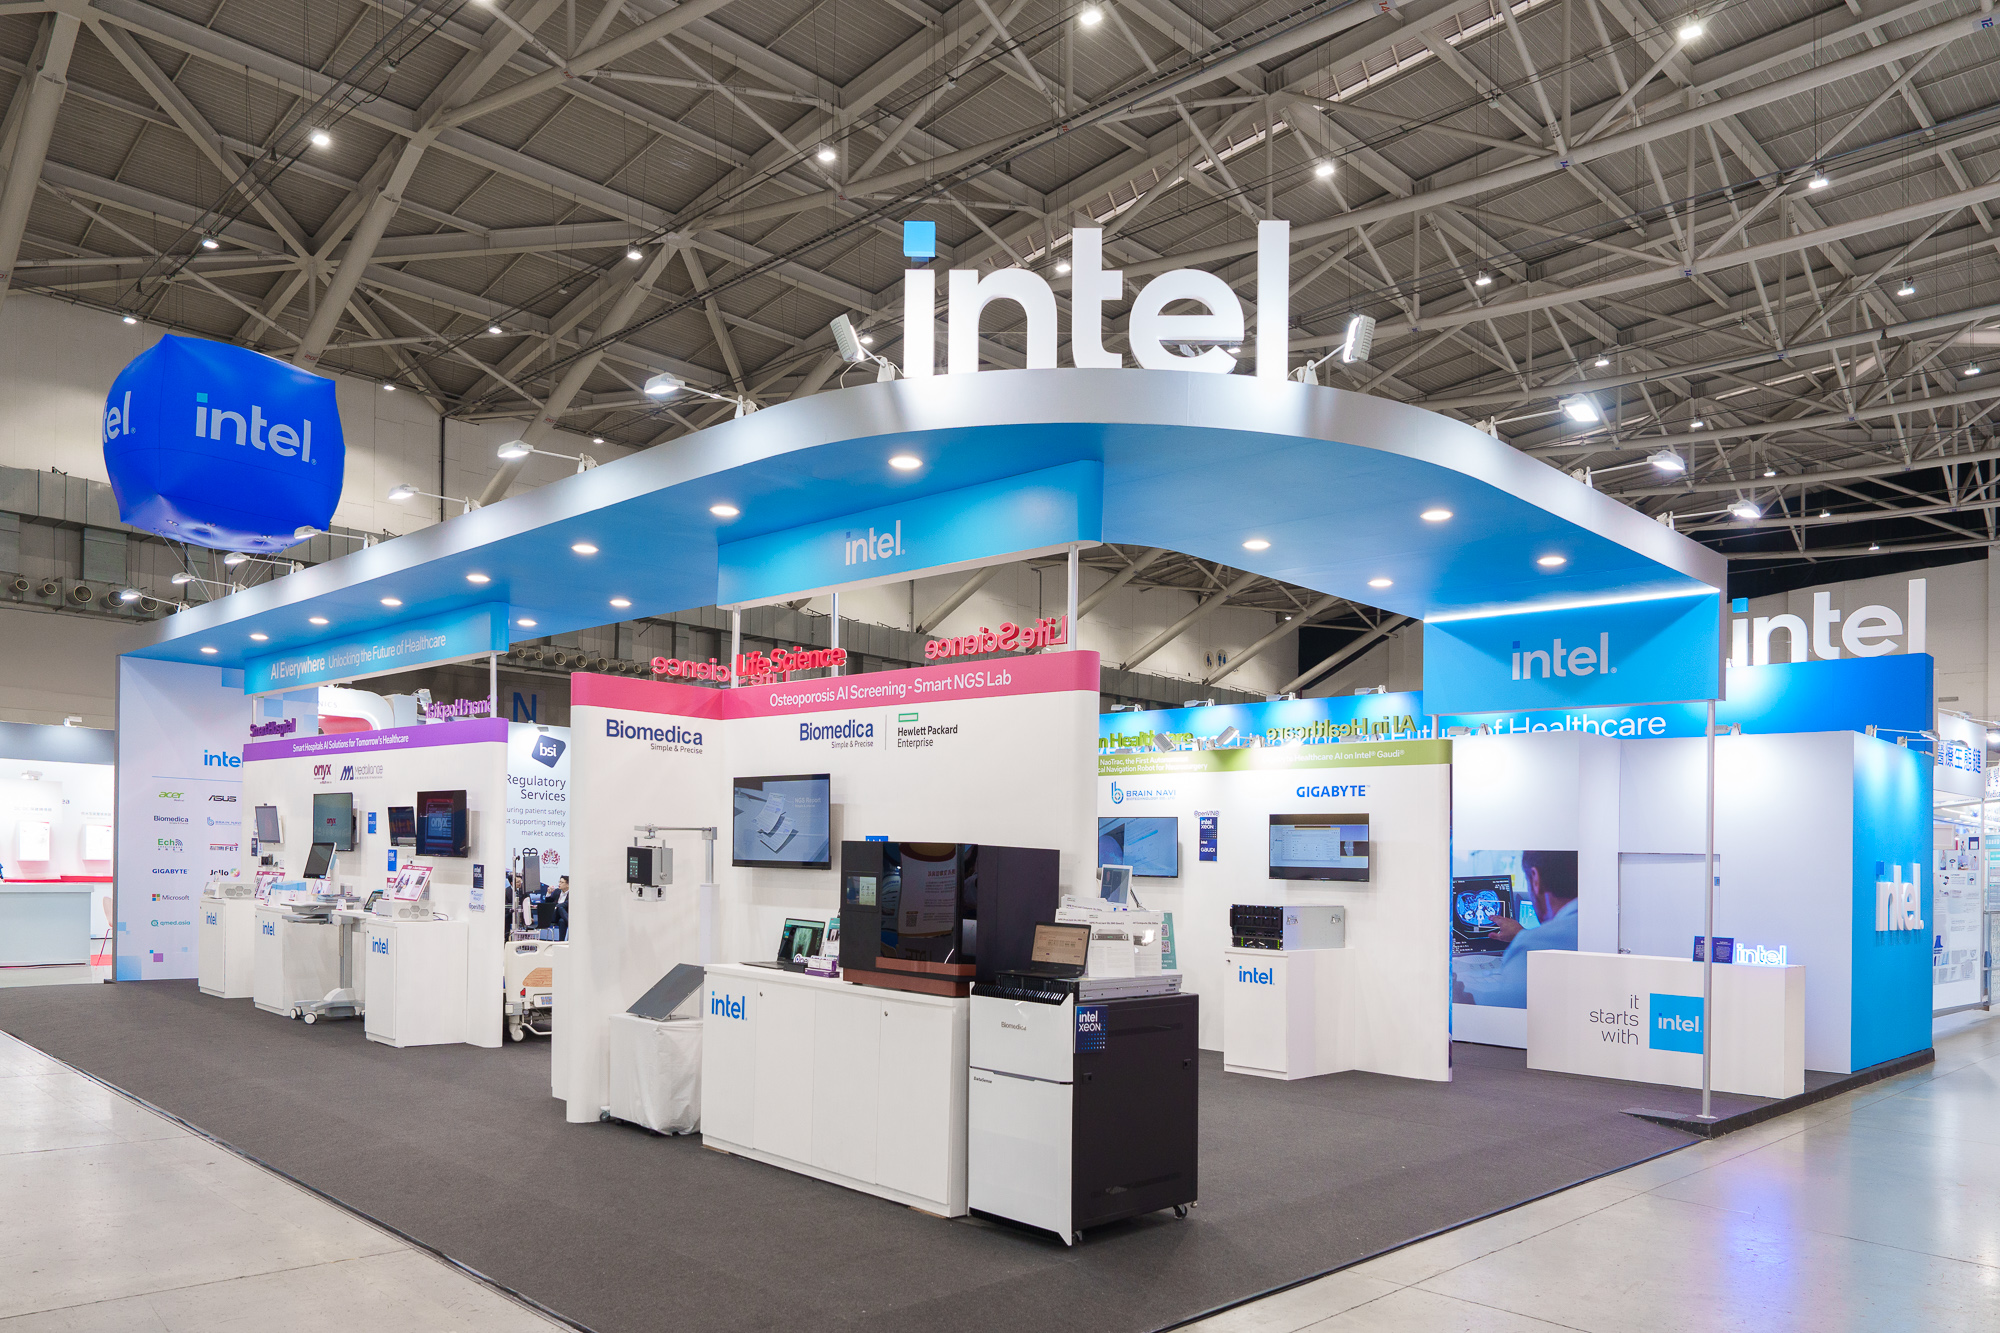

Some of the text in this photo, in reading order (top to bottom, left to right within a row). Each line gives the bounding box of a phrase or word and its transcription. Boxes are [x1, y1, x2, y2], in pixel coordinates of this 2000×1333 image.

[903, 220, 1290, 381] intel
[1731, 578, 1926, 667] intel
[270, 634, 446, 680] AI Everywhere Unlocking the Future of Healthcare
[736, 646, 847, 677] Life Science
[769, 687, 835, 708] Osteoporosis
[836, 686, 849, 701] AI
[849, 681, 907, 701] Screening
[914, 677, 952, 694] Smart
[953, 672, 985, 689] NGS
[986, 670, 1012, 687] Lab
[513, 692, 537, 722] N
[606, 718, 703, 746] Biomedica
[799, 719, 874, 743] Biomedica
[897, 723, 958, 737] Hewlett Packard
[1509, 713, 1667, 738] Healthcare
[293, 742, 305, 753] Smart
[305, 741, 324, 753] Hospitals
[324, 741, 329, 750] AI
[329, 740, 348, 750] Solutions
[382, 735, 409, 746] Healthcare
[831, 740, 848, 750] Simple
[854, 739, 874, 748] Precise
[897, 737, 934, 750] Enterprise
[1109, 730, 1194, 748] Healthare
[539, 742, 557, 757] bsi
[650, 743, 673, 753] Simple
[680, 746, 703, 755] Precise
[1294, 752, 1333, 762] Healthcare
[1334, 751, 1343, 760] AI
[1343, 752, 1354, 760] on
[1100, 758, 1124, 766] NaoTrac,
[1125, 757, 1135, 765] the
[1106, 765, 1136, 774] Navigation
[1137, 764, 1155, 772] Robot
[1155, 763, 1165, 771] for
[313, 763, 332, 780] onyx
[507, 774, 567, 791] Regulatory
[158, 791, 185, 799] acer
[208, 794, 237, 803] ASUS
[520, 788, 566, 802] Services
[1296, 785, 1366, 798] GIGABYTE
[153, 815, 189, 823] Biomedica
[524, 806, 547, 817] patient
[547, 808, 567, 818] safety
[512, 817, 547, 828] supporting
[547, 818, 567, 829] timely
[521, 829, 566, 838] market access.
[1876, 861, 1922, 933] intel
[206, 911, 218, 926] intel
[262, 920, 274, 936] intel
[372, 936, 388, 954] intel
[1736, 943, 1787, 966] intel
[1238, 965, 1273, 985] intel
[711, 990, 745, 1021] intel
[1629, 994, 1640, 1010] it
[1078, 1010, 1099, 1023] intel
[1589, 1009, 1640, 1029] starts
[1657, 1012, 1701, 1033] intel
[1001, 1021, 1027, 1031] Biomedica
[1601, 1028, 1640, 1046] with
